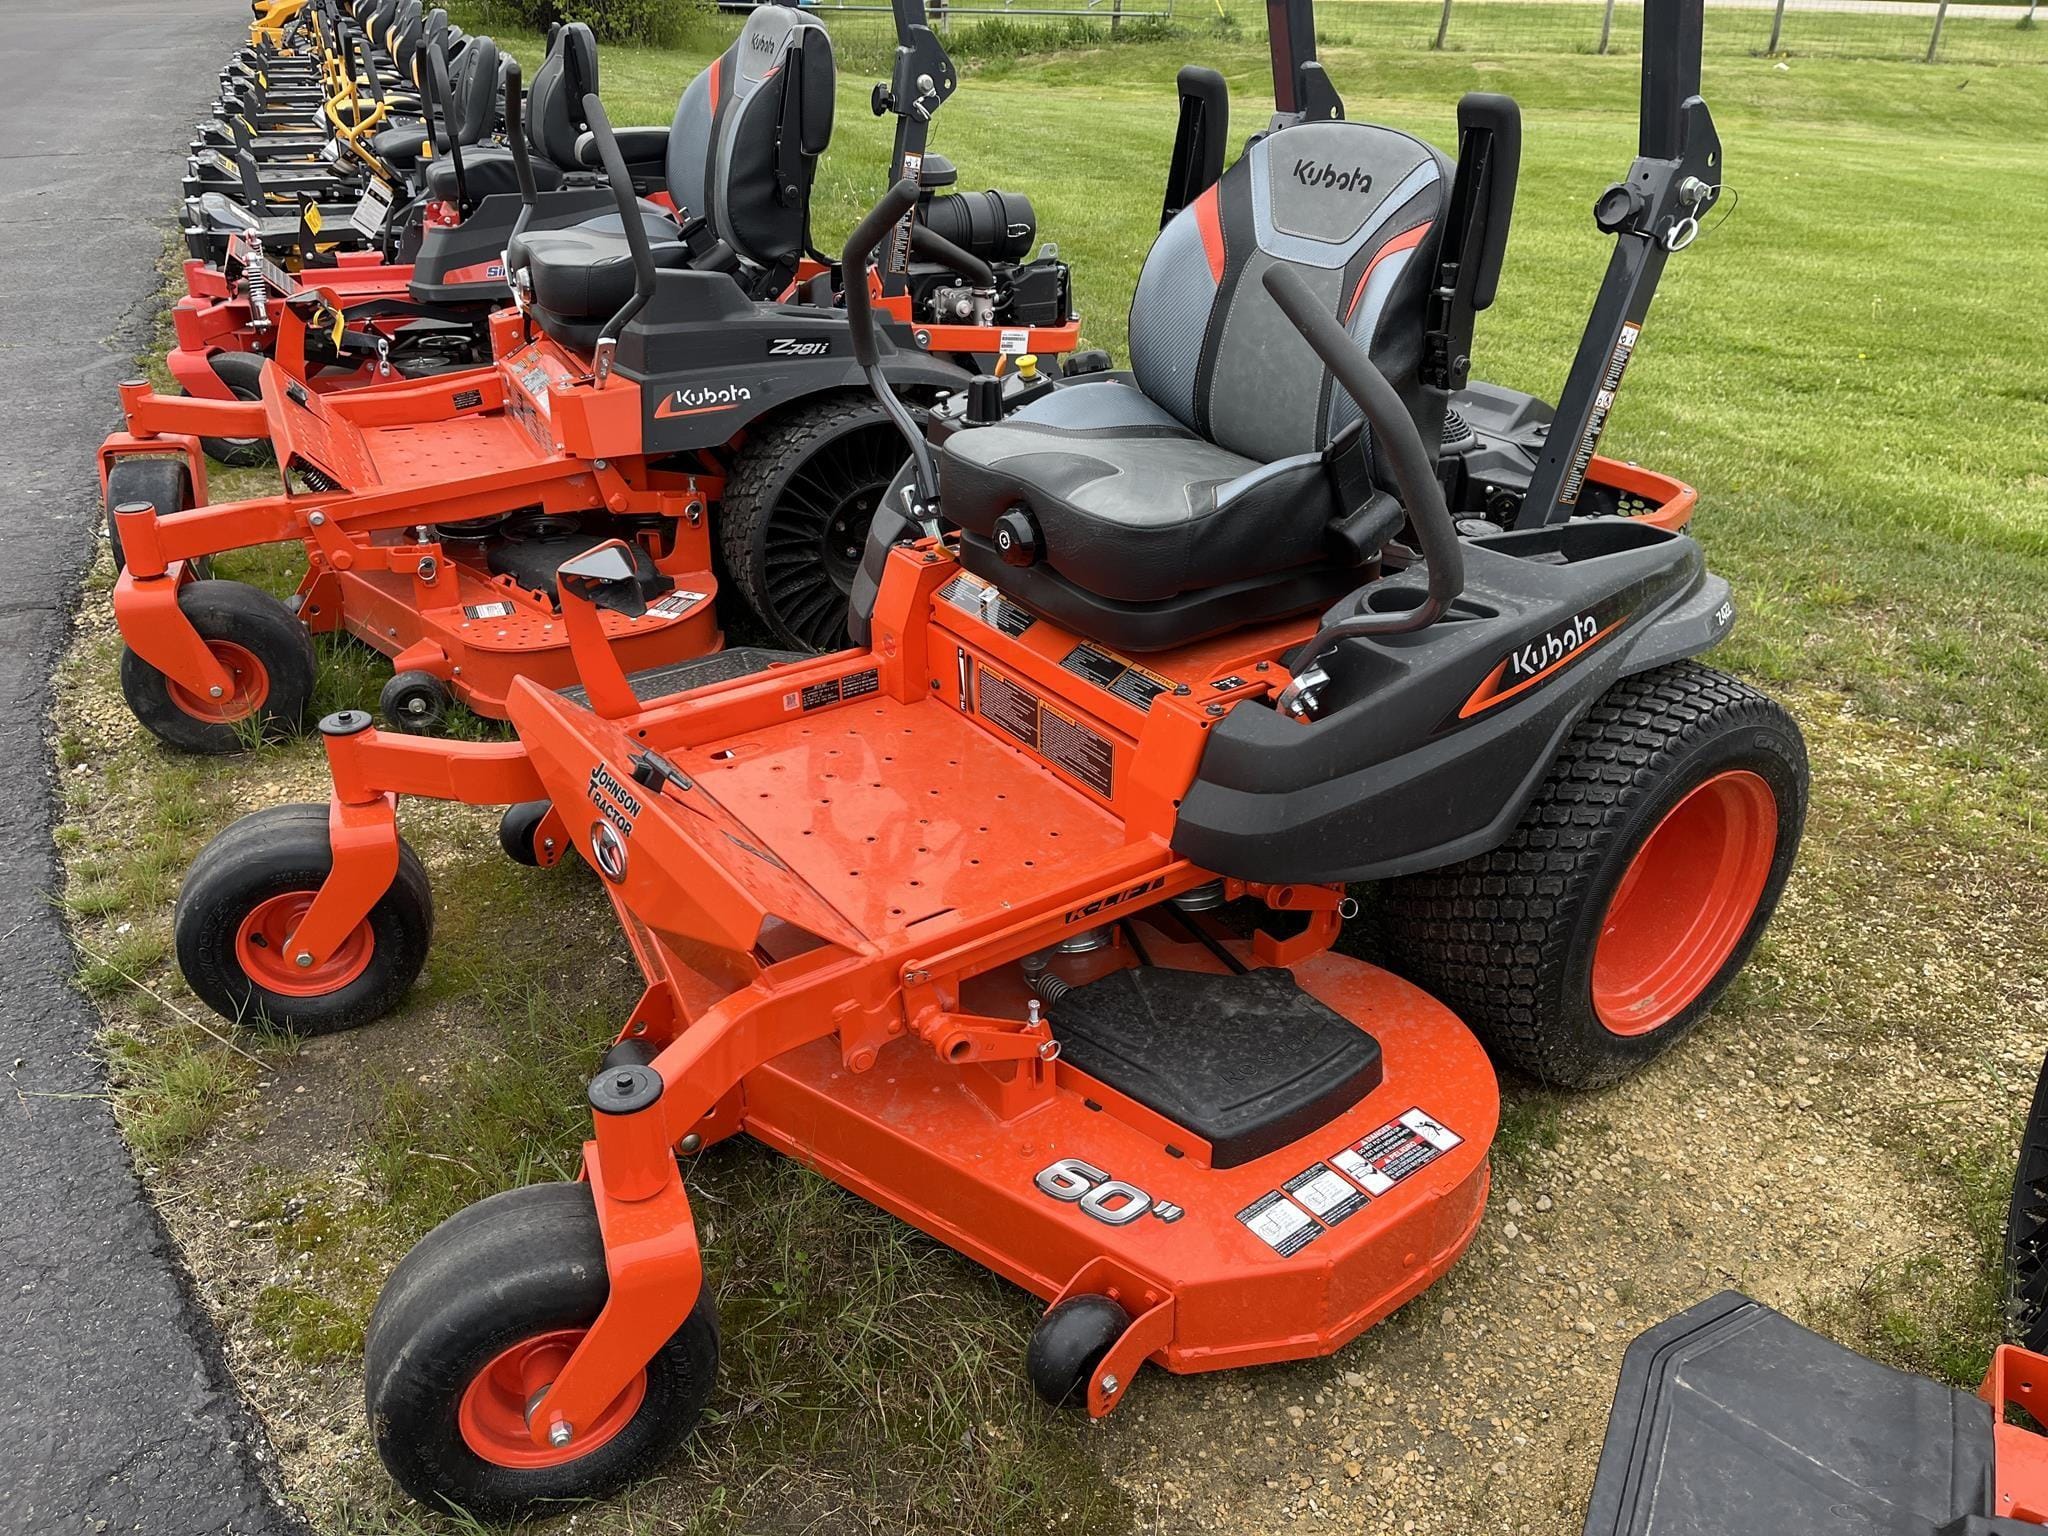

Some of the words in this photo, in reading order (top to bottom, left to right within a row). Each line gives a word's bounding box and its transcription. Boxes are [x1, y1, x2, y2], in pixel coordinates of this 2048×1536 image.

[1293, 159, 1373, 194] Kubota
[769, 338, 829, 355] Z781i
[676, 384, 751, 406] Kubota
[1512, 614, 1598, 675] Kubota
[591, 762, 642, 818] JOHNSON
[587, 778, 633, 838] TRACTOR
[1364, 1124, 1391, 1143] DANGER
[1389, 1141, 1417, 1160] PELIGRO
